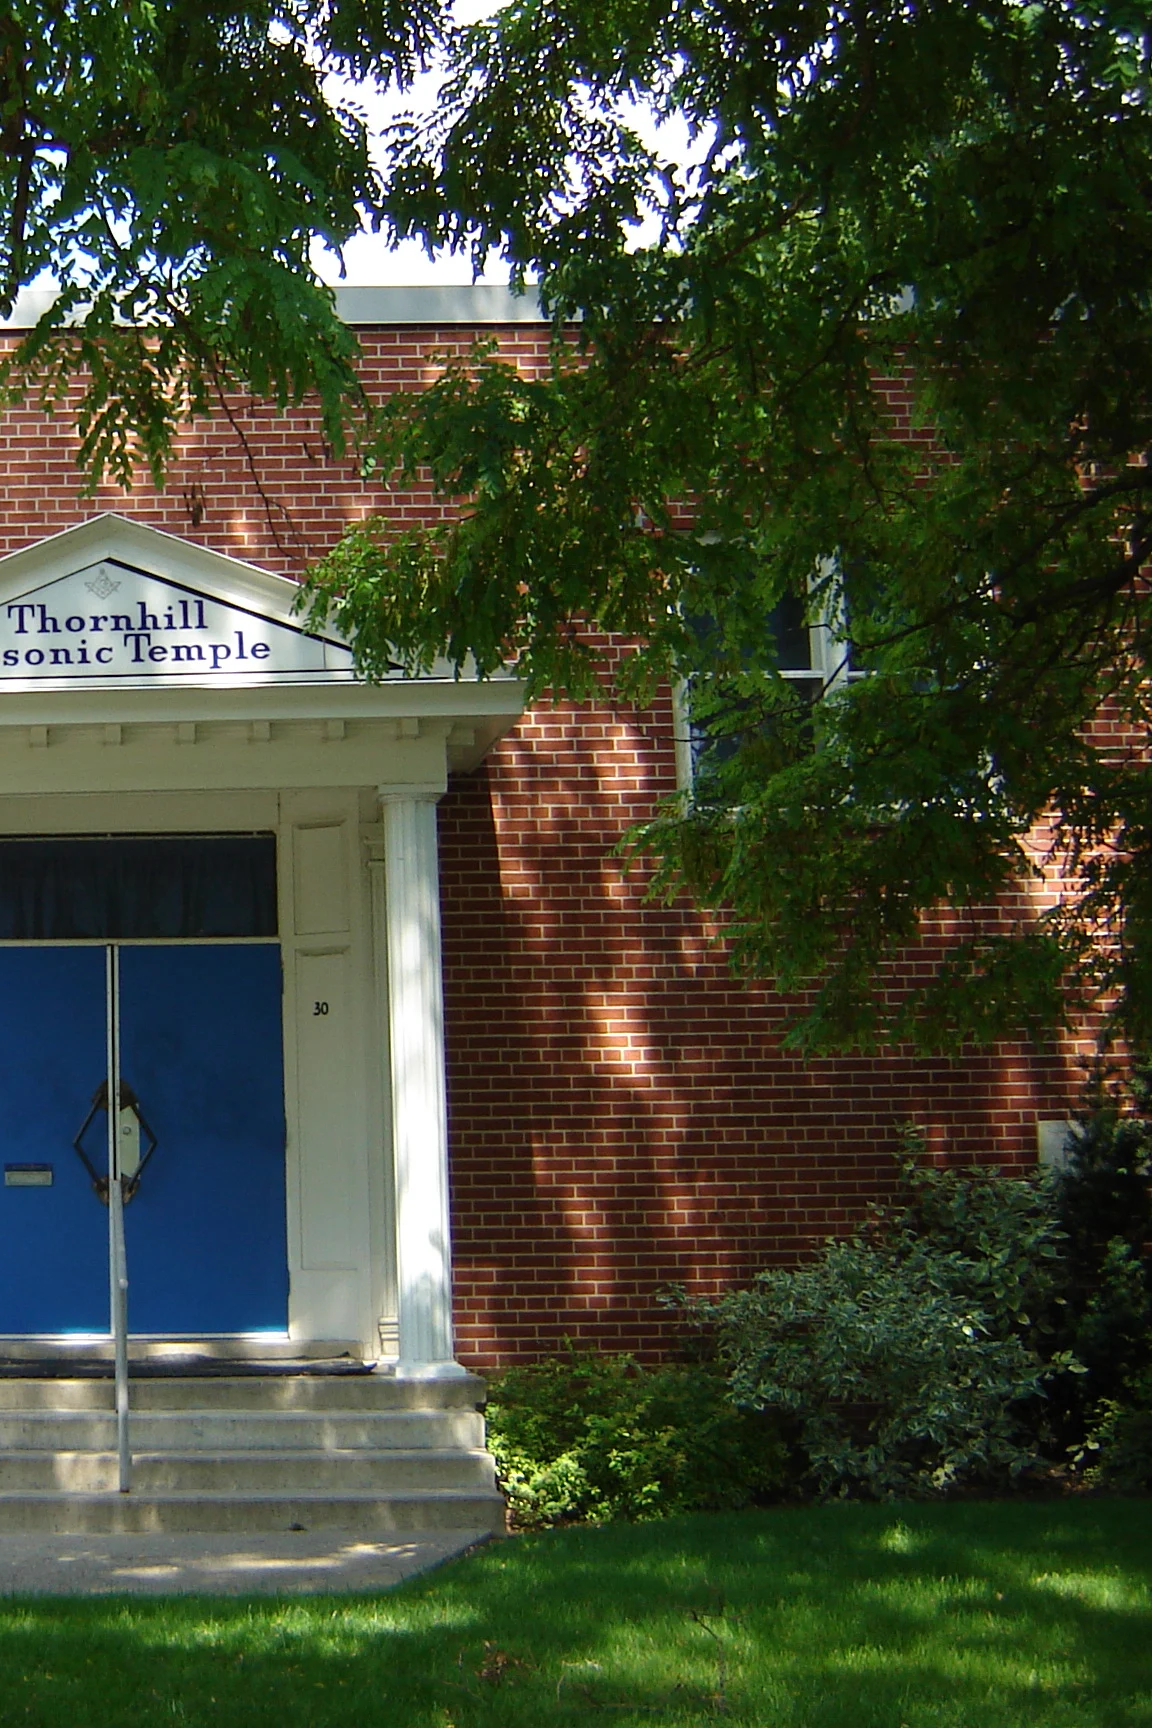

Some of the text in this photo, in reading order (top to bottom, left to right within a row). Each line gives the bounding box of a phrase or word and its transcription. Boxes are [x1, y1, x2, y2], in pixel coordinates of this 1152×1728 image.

[7, 600, 208, 633] Thornhill
[123, 631, 271, 669] Temple
[313, 1001, 329, 1016] 30
